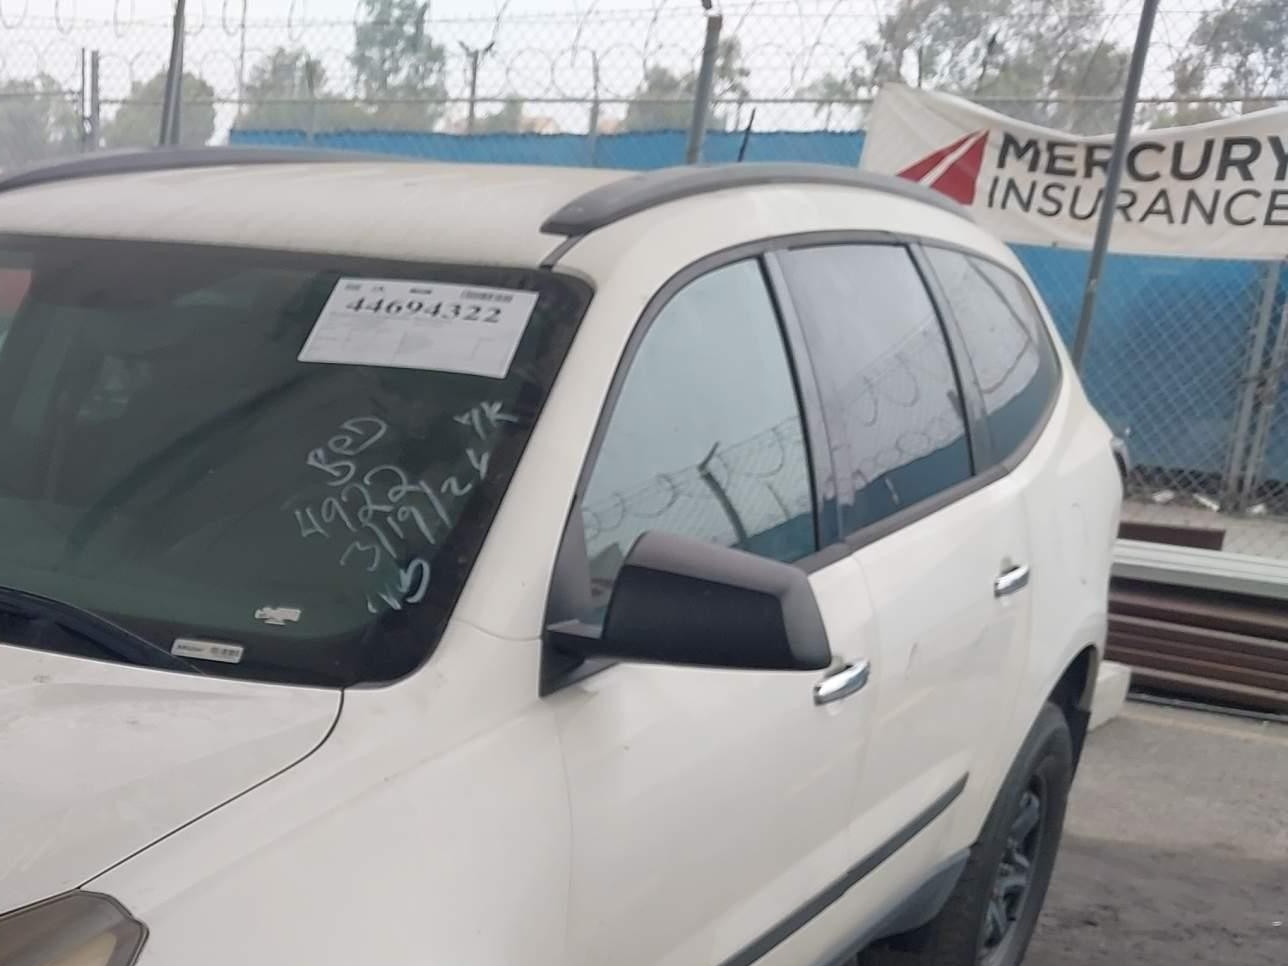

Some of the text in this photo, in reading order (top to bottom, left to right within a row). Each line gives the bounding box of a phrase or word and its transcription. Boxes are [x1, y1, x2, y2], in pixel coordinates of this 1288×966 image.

[996, 132, 1288, 182] MERCURY
[987, 175, 1288, 227] INSURANCE
[345, 297, 502, 324] 44694322
